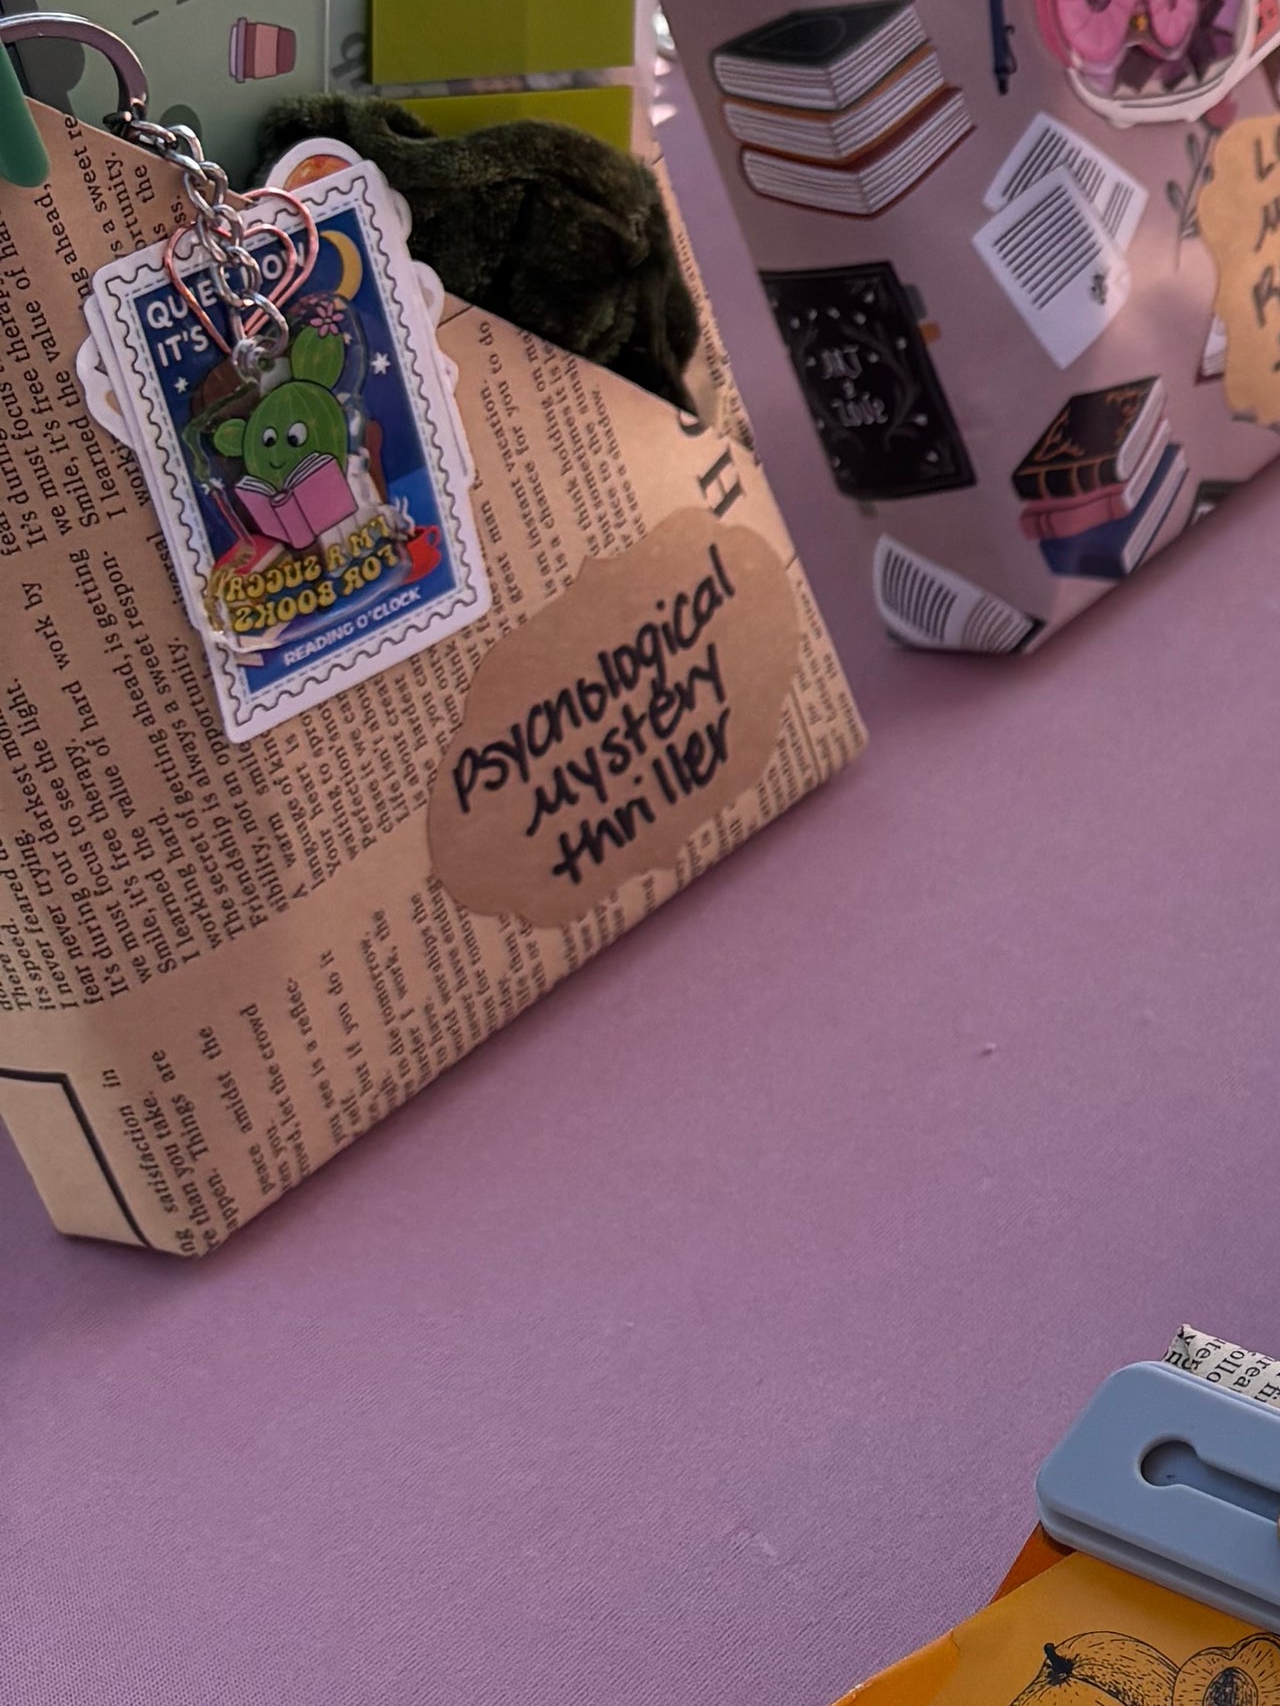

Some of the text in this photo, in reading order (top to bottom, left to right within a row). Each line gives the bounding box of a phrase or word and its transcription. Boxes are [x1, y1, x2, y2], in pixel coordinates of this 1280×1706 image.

[156, 324, 210, 368] IT'S
[283, 586, 422, 668] READING O'CLOCK
[525, 641, 729, 837] mystery
[551, 708, 734, 886] thriller
